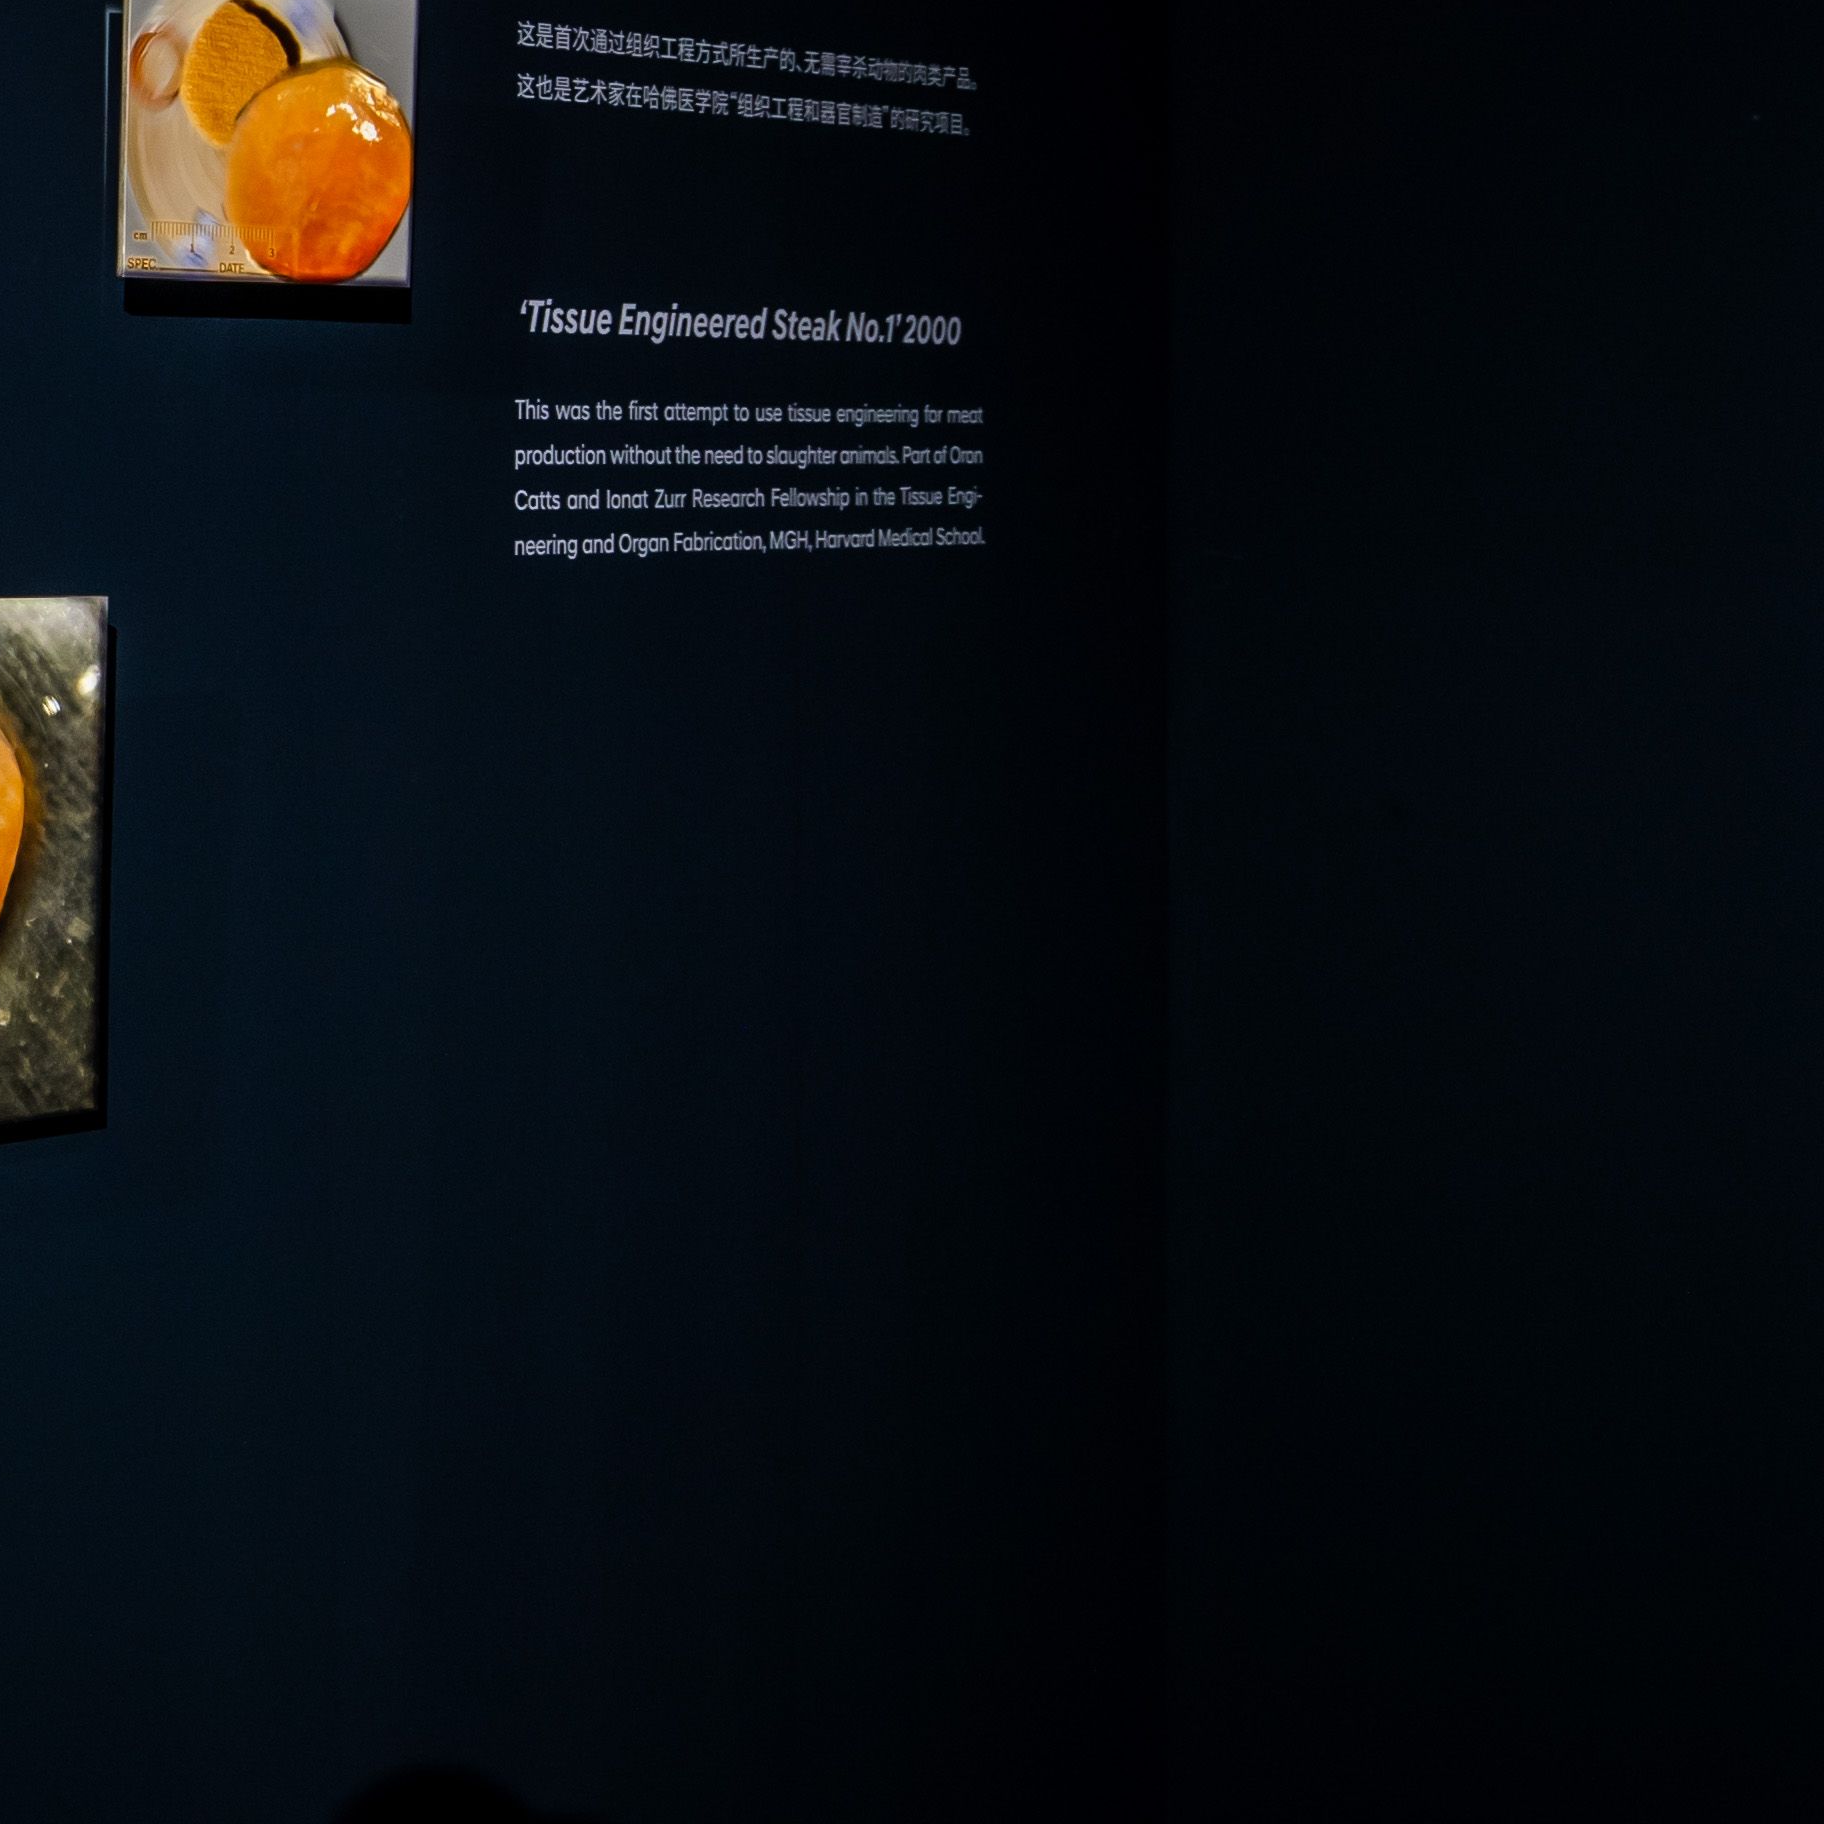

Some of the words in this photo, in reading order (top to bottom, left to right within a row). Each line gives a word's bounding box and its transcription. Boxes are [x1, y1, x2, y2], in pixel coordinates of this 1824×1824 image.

[133, 231, 148, 240] cm
[229, 246, 235, 255] 2
[269, 247, 276, 258] 3
[219, 262, 245, 273] DATE
[617, 302, 769, 345] Engineered
[771, 307, 843, 342] Steak
[902, 314, 962, 346] 2000
[513, 397, 551, 421] This
[554, 403, 592, 422] was
[594, 399, 624, 422] the
[627, 399, 660, 422] first
[663, 402, 730, 427] attempt
[732, 403, 751, 423] to
[754, 406, 784, 423] use
[786, 401, 832, 423] tissue
[835, 403, 920, 429] engineering
[923, 403, 944, 424] for
[946, 407, 984, 424] meat
[513, 443, 608, 471] production
[609, 443, 673, 466] without
[673, 443, 702, 466] the
[703, 444, 745, 466] need
[745, 446, 765, 466] to
[765, 444, 839, 470] slaughter
[839, 444, 901, 465] animals.
[901, 445, 932, 465] Part
[932, 444, 948, 465] of
[949, 445, 984, 465] Oran
[513, 488, 562, 512] Catts
[565, 488, 601, 511] and
[653, 487, 688, 510] Zurr
[691, 487, 766, 509] Research
[770, 486, 851, 512] Fellowship
[854, 486, 869, 507] in
[871, 486, 897, 507] the
[898, 485, 944, 506] Tissue
[947, 485, 983, 510] Engi-
[513, 532, 579, 561] neering
[581, 531, 616, 555] and
[617, 532, 671, 559] Organ
[672, 529, 768, 554] Fabrication,
[768, 529, 814, 553] MGH,
[814, 528, 876, 550] Harvard
[877, 527, 934, 548] Medical
[935, 526, 986, 547] School.
